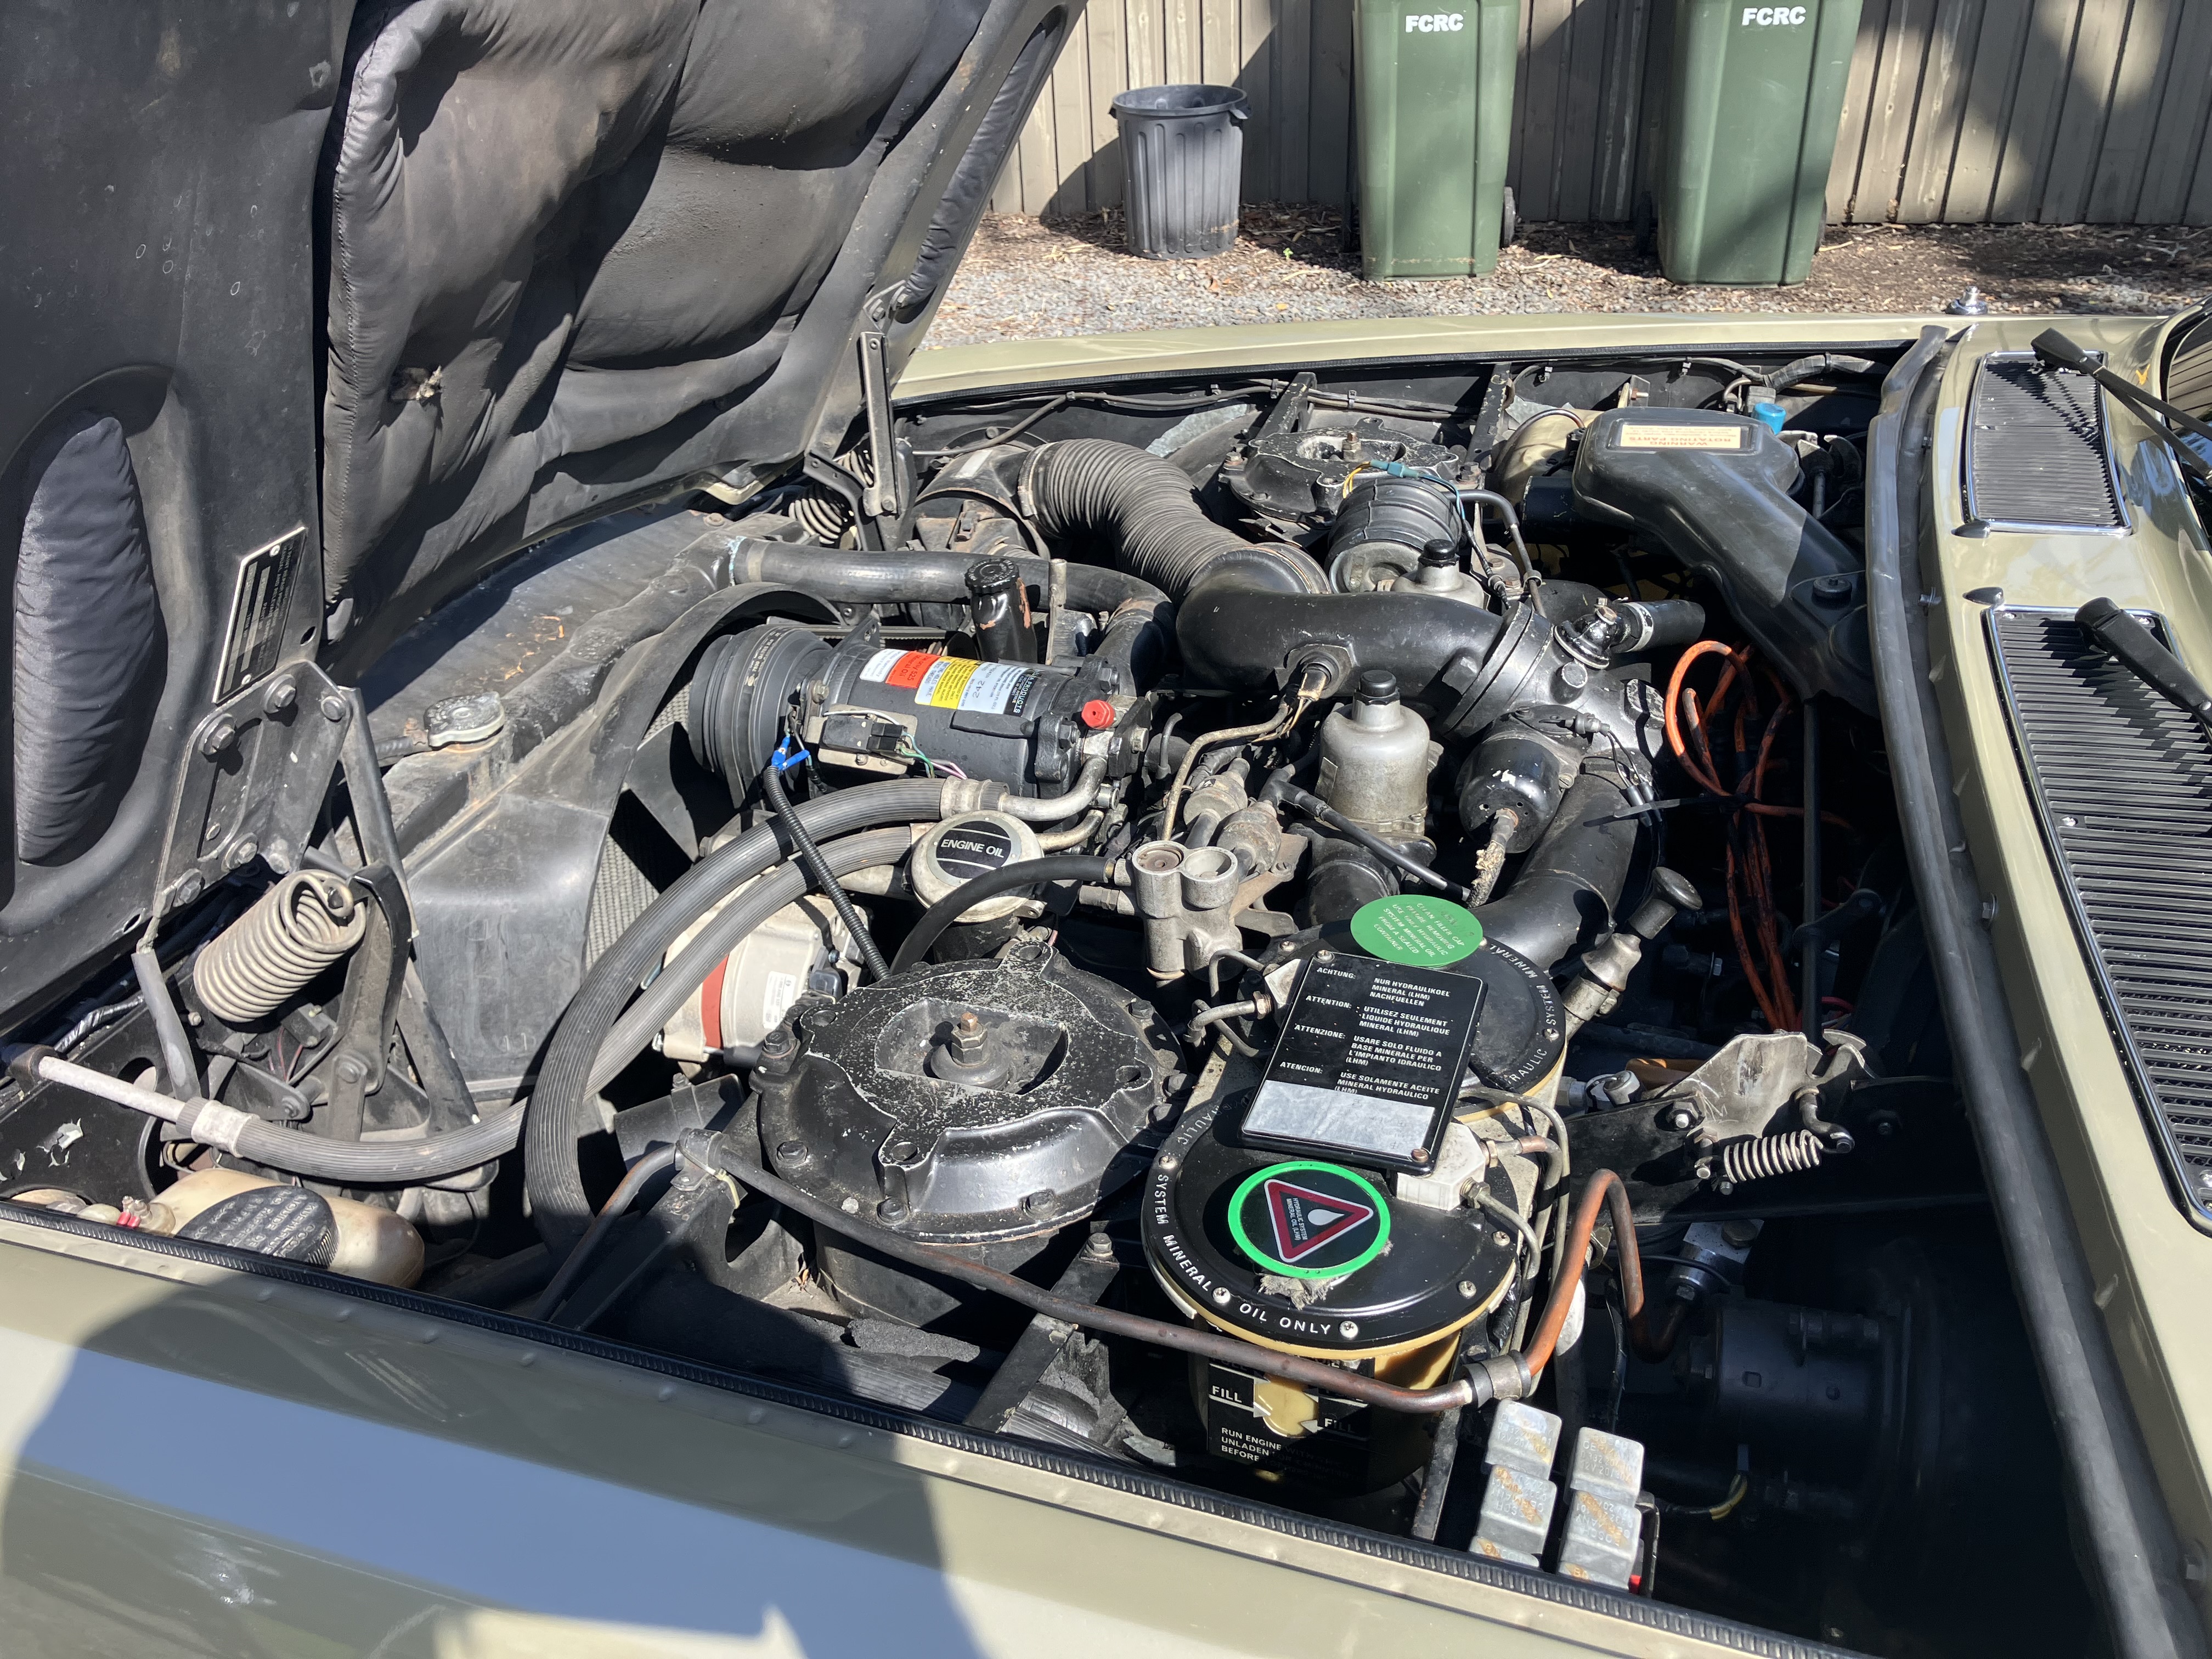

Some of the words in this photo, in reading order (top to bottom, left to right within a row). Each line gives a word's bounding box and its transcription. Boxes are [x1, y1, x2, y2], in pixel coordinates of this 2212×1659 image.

[1404, 13, 1464, 33] FCRC
[1741, 5, 1806, 26] FCRC
[907, 670, 917, 680] 525
[972, 681, 985, 698] 242
[1014, 681, 1032, 713] PRODUCTS
[941, 839, 985, 852] ENGINE
[986, 846, 1004, 857] OIL
[1373, 924, 1403, 951] CONTAINER
[1378, 917, 1395, 932] FROM
[1398, 935, 1419, 954] SEALED
[1383, 908, 1404, 927] SYSTEM
[1403, 926, 1426, 952] MINERAL
[1425, 949, 1436, 958] OIL
[1392, 904, 1404, 916] USE
[1417, 928, 1449, 956] HYDRAULIC
[1426, 924, 1455, 949] REMOVING
[1434, 918, 1452, 935] FILLER
[1452, 935, 1465, 947] CAP
[1489, 943, 1538, 979] MINERAL
[1317, 967, 1356, 980] ACHTUNG:
[1372, 984, 1407, 996] MINERAL
[1408, 990, 1430, 1001] (LHM)
[1374, 978, 1391, 988] NUR
[1391, 980, 1450, 998] HYDRAULIKOEL
[1305, 995, 1352, 1009] ATTENTION:
[1369, 991, 1425, 1007] NACHFUELLEN
[1536, 985, 1556, 1026] SYSTEM
[1361, 1013, 1392, 1025] LIQUIDE
[1394, 1018, 1451, 1036] HYDRAULIQUE
[1363, 1006, 1398, 1018] UTILISEZ
[1400, 1012, 1448, 1027] SEULEMENT
[1294, 1024, 1346, 1040] ATTENZIONE:
[1359, 1020, 1395, 1033] MINERAL
[1396, 1026, 1419, 1038] (LHM)
[1351, 1042, 1377, 1054] BASE
[1378, 1047, 1416, 1060] MINERALE
[1417, 1054, 1434, 1063] PER
[1353, 1035, 1380, 1047] USARE
[1381, 1040, 1403, 1051] SOLO
[1405, 1043, 1434, 1056] FLUIDO
[1279, 1061, 1323, 1074] ATENCION:
[1346, 1057, 1369, 1066] (LHM)
[1348, 1049, 1396, 1064] L'IMPIANTO
[1397, 1058, 1442, 1072] IDRAULICO
[1508, 1048, 1548, 1086] RAULIC
[1334, 1086, 1358, 1094] (LHM)
[1337, 1079, 1374, 1091] MINERAL
[1375, 1085, 1429, 1100] HYDRAULICO
[1340, 1071, 1357, 1080] USE
[1358, 1074, 1409, 1090] SOLAMENTE
[1410, 1084, 1440, 1094] ACEITE
[1286, 1198, 1295, 1219] MINERAL
[1293, 1198, 1302, 1222] HYDRAULIC
[1299, 1221, 1307, 1240] SYSTEM
[1153, 1173, 1169, 1226] SYSTEM
[1163, 1233, 1211, 1292] MINERAL
[1238, 1302, 1267, 1323] OIL
[1279, 1316, 1331, 1336] ONLY
[1211, 1385, 1243, 1404] FILL
[1324, 1418, 1355, 1433] FILL
[1221, 1427, 1243, 1440] RUN
[1245, 1433, 1282, 1451] ENGINE
[1221, 1436, 1270, 1457] UNLADEN
[1221, 1445, 1260, 1462] BEFORE
[1580, 1460, 1596, 1472] 12V
